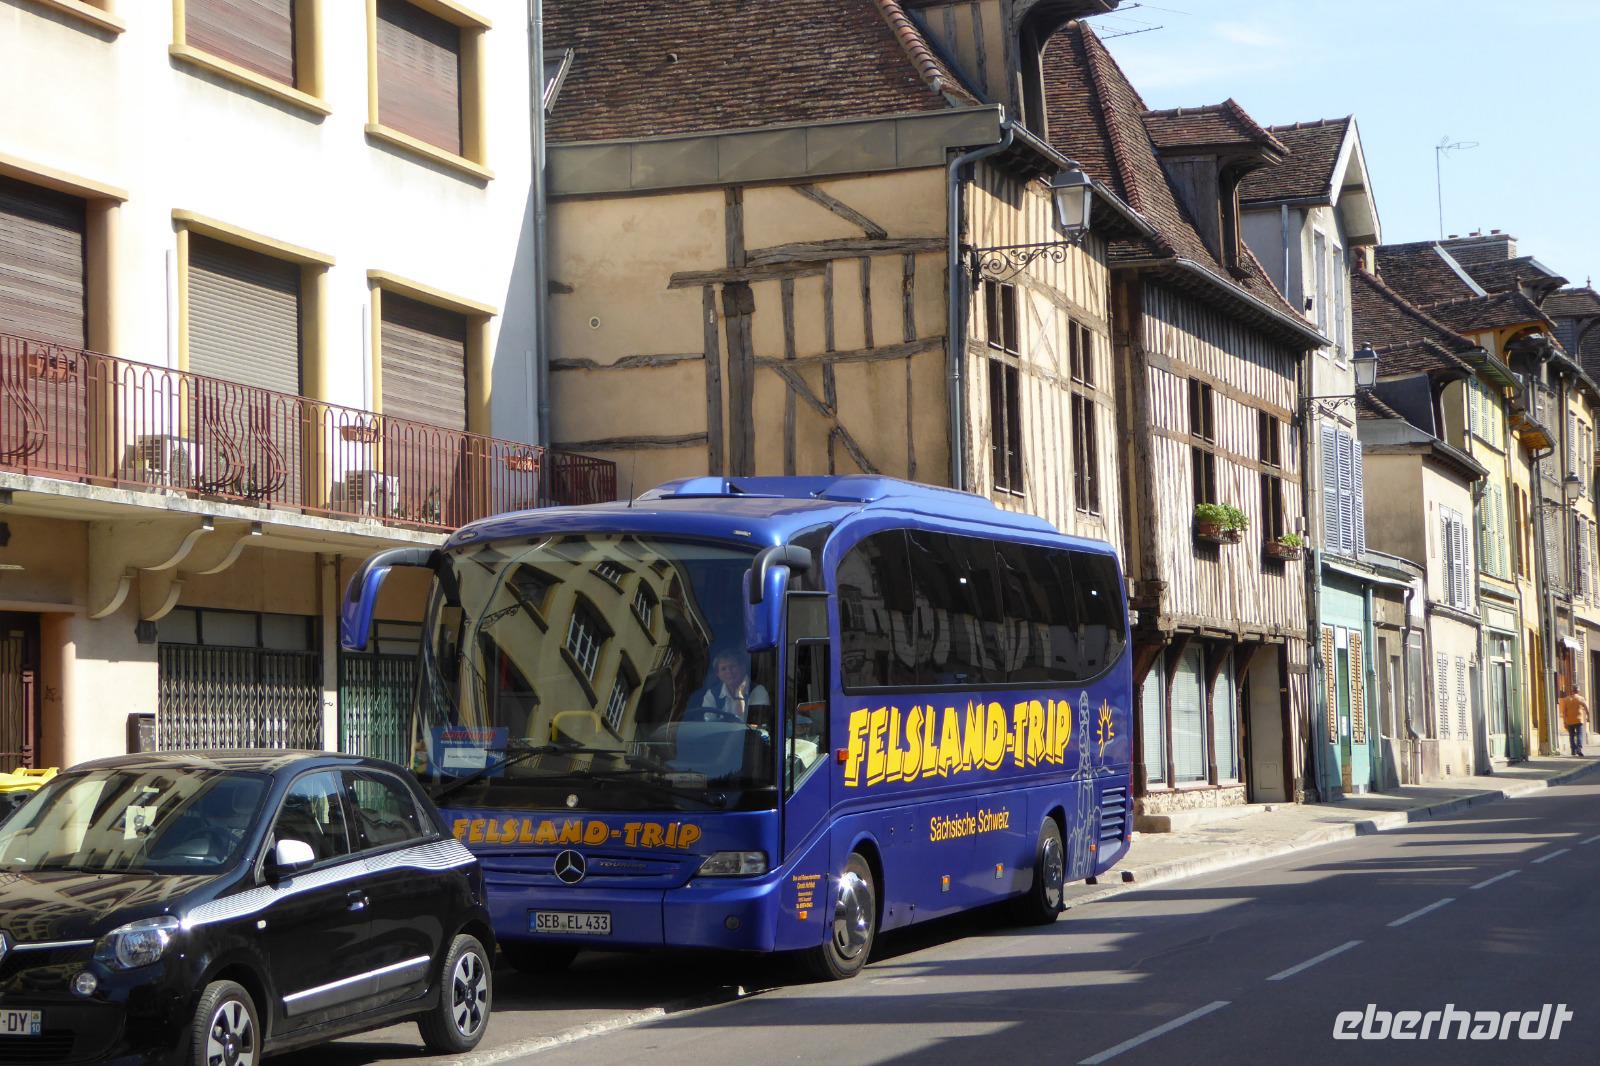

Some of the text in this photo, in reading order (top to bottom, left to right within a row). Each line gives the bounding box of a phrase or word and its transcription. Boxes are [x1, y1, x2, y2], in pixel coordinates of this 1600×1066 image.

[844, 699, 1072, 787] FELSLAND-TRIP
[453, 818, 702, 848] FELSLAND-TRIP
[930, 806, 1009, 842] Sächsische Schweiz
[537, 914, 608, 930] SEB EL 433
